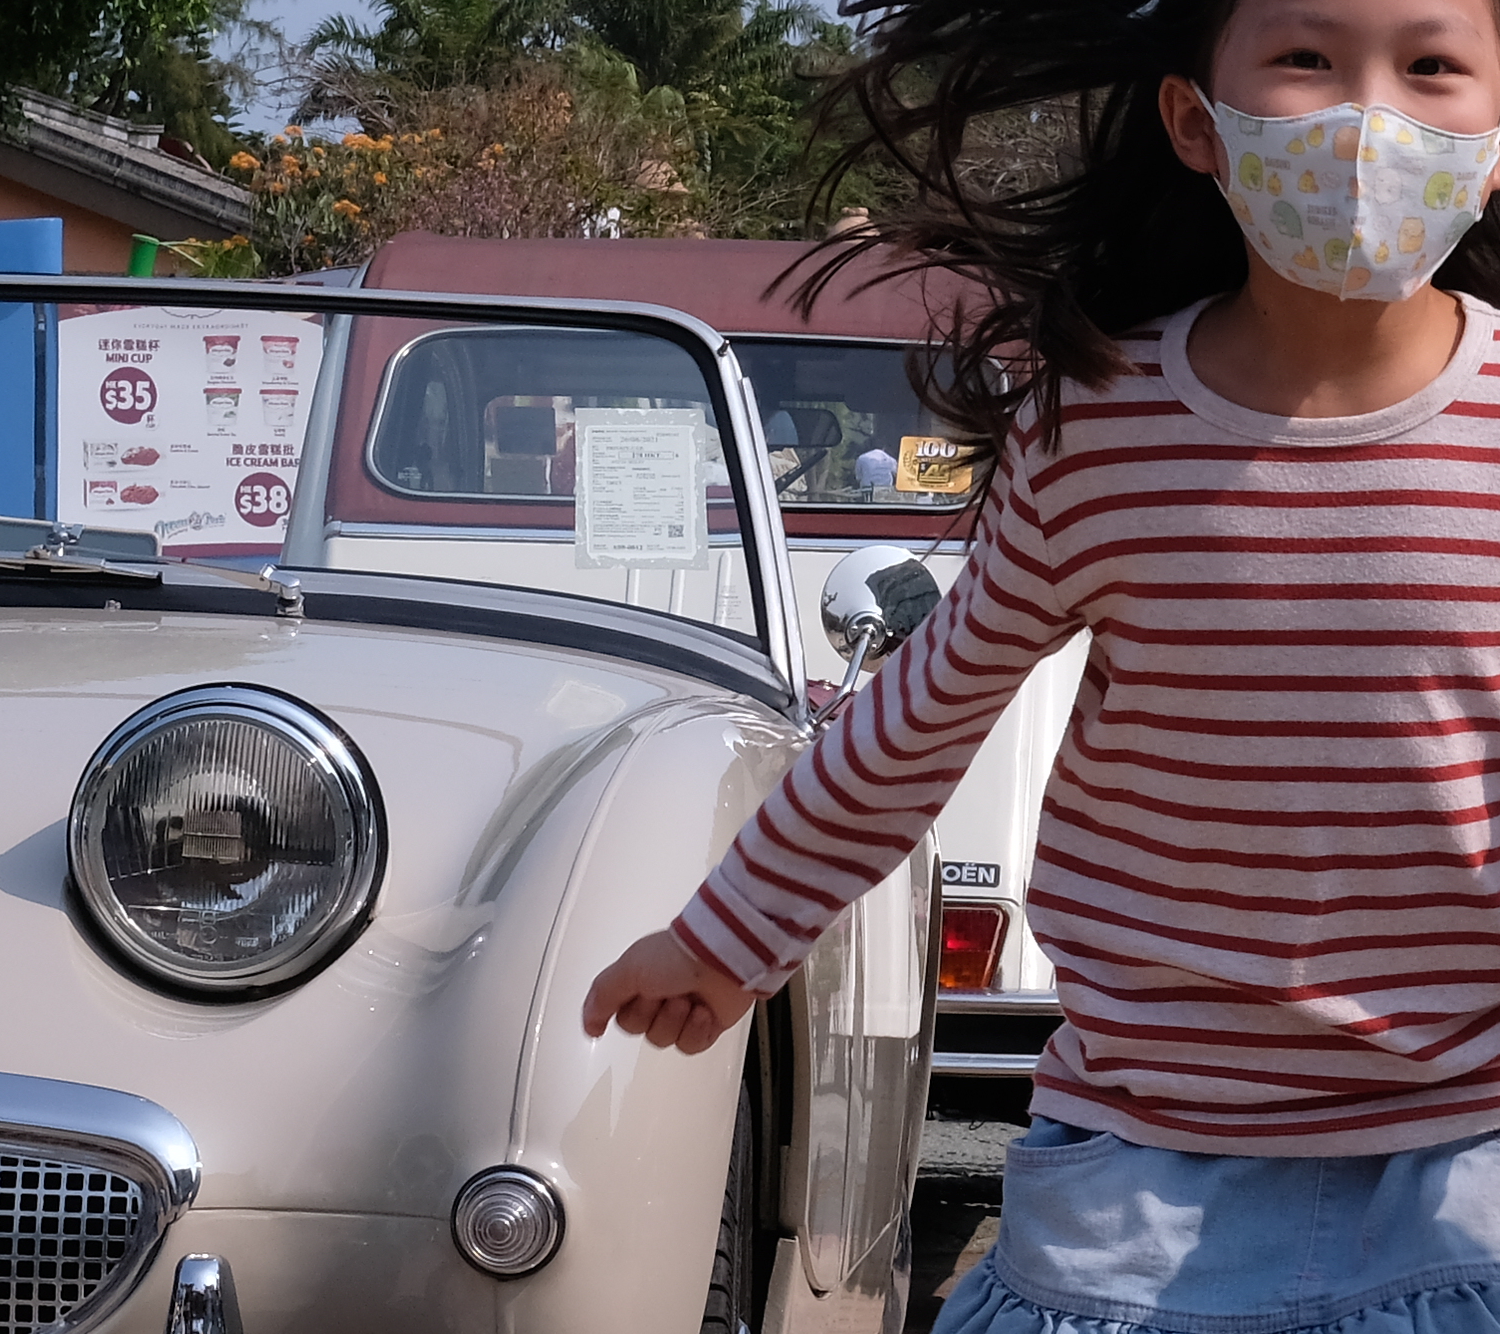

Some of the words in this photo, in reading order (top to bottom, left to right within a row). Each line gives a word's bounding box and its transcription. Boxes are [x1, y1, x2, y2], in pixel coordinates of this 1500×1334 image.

[98, 338, 160, 352] 迷你雪糕杯
[105, 354, 129, 364] MINI
[131, 354, 153, 364] CUP
[231, 444, 295, 456] 脆皮雪糕批
[915, 441, 958, 458] 100
[226, 457, 243, 467] ICE
[244, 457, 279, 468] CREAM
[942, 862, 996, 884] OËN
